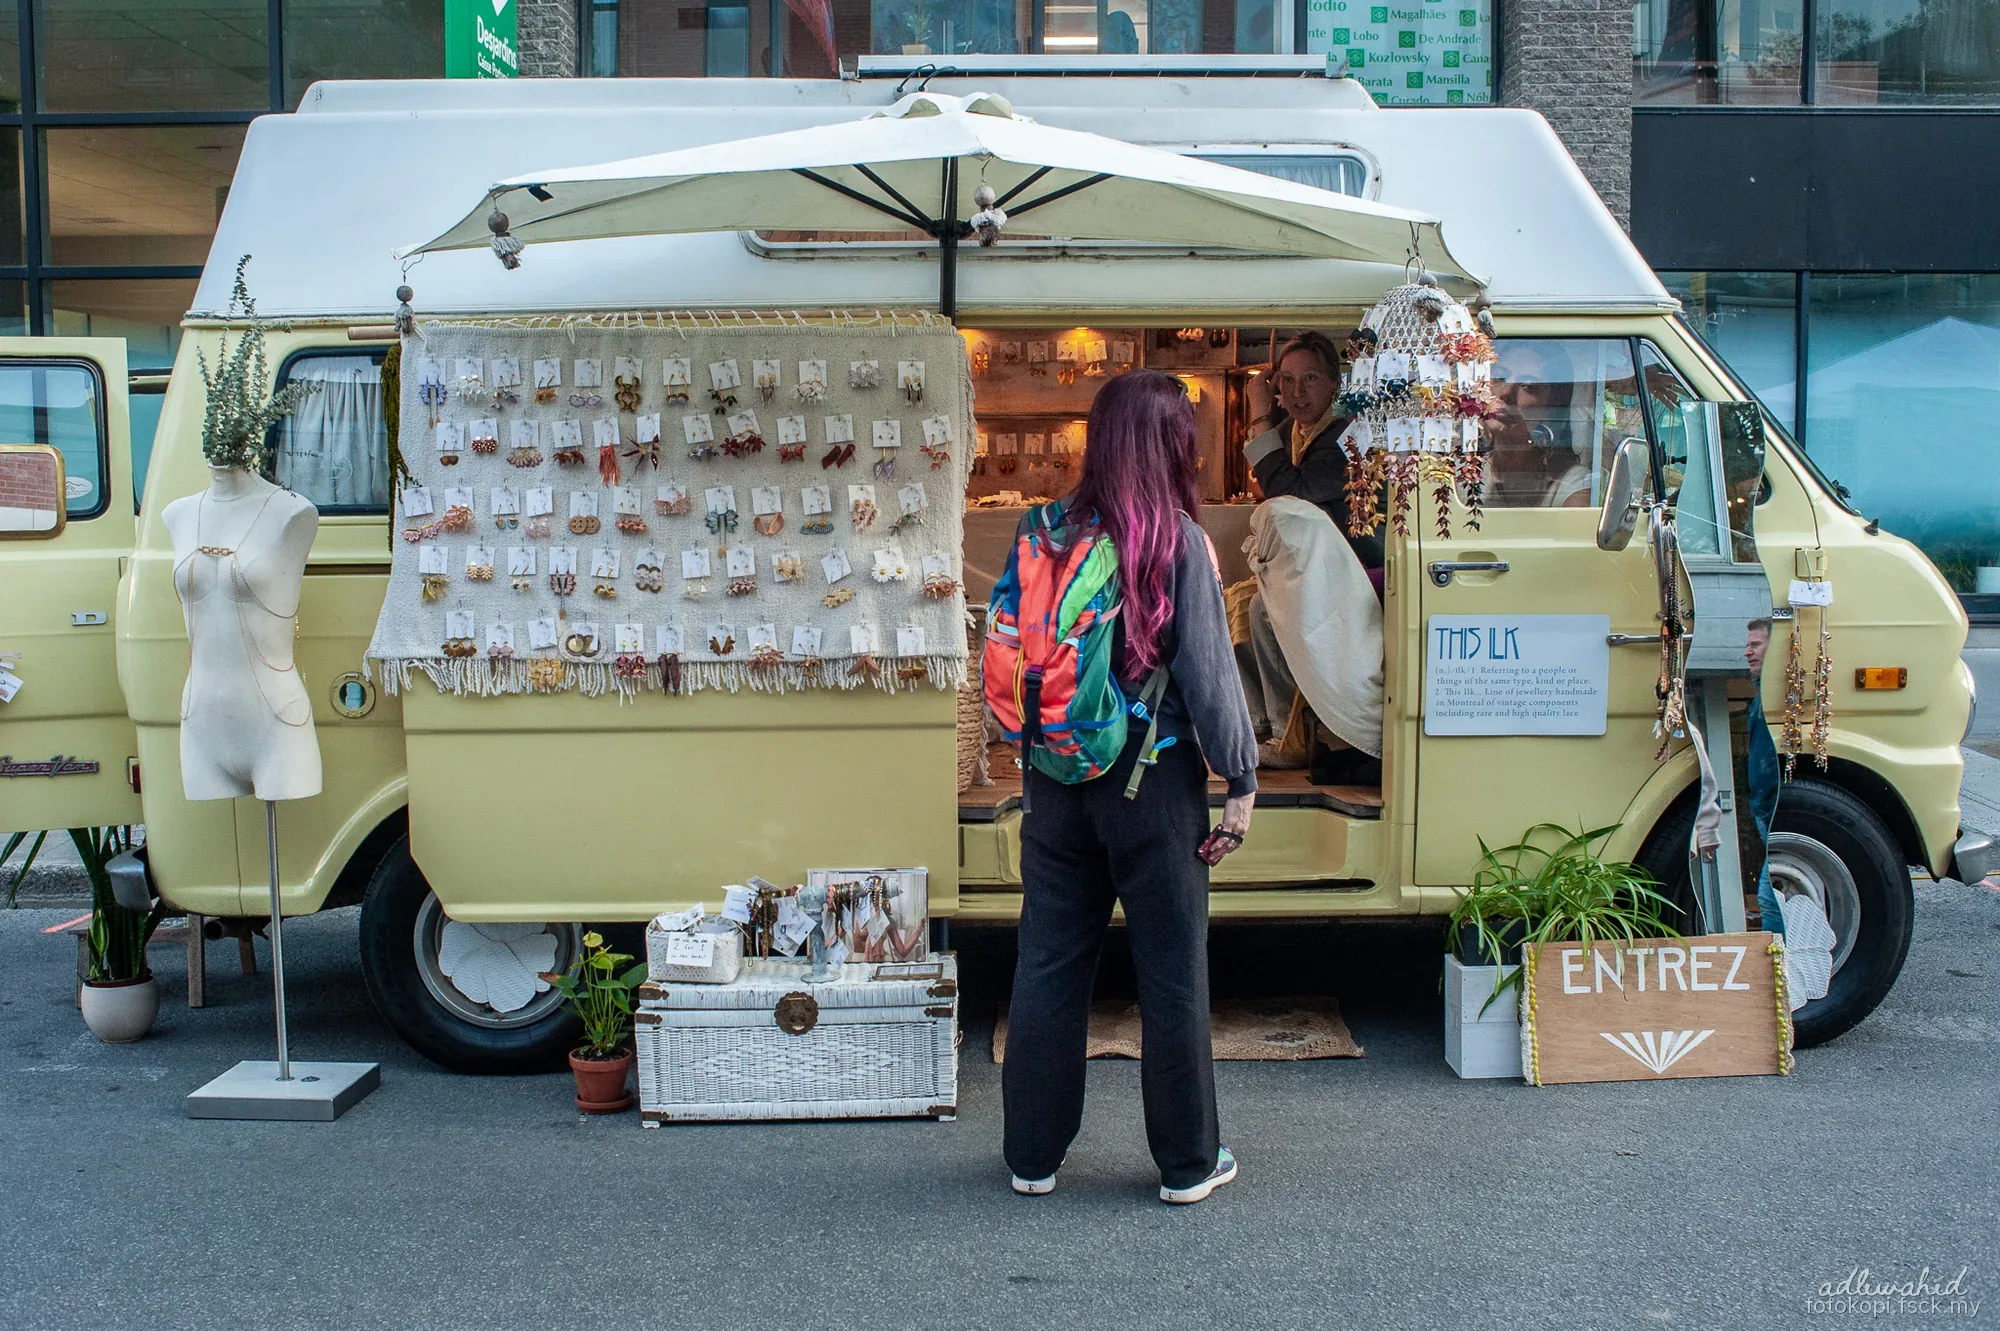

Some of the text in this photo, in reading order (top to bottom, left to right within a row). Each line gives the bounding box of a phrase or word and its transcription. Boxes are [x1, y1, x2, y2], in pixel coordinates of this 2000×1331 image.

[1391, 9, 1446, 21] Magalhães
[1353, 30, 1379, 41] Lobo
[1419, 33, 1481, 44] De Andrade
[477, 15, 517, 70] Desjardins
[1369, 51, 1430, 67] Kozlowsky
[1463, 53, 1490, 63] Cana
[1358, 77, 1393, 87] Barata
[1426, 74, 1470, 84] Mansilla
[1435, 627, 1520, 660] THIS ILK
[1480, 666, 1520, 676] Referring
[1538, 666, 1566, 676] people
[1436, 677, 1462, 686] things
[1464, 677, 1474, 685] of
[1475, 677, 1489, 685] the
[1513, 678, 1533, 686] type,
[1535, 677, 1554, 685] kind
[1567, 676, 1590, 686] place.
[1505, 687, 1515, 695] of
[1515, 687, 1553, 697] jewellery
[1555, 687, 1597, 695] handmade
[1486, 698, 1496, 706] of
[1497, 700, 1527, 708] vintage
[1528, 700, 1578, 708] components
[1435, 709, 1475, 719] including
[1494, 709, 1510, 717] and
[1511, 709, 1530, 718] high
[1532, 709, 1560, 718] quality
[1562, 709, 1581, 717] lace.
[1561, 945, 1750, 994] ENTREZ
